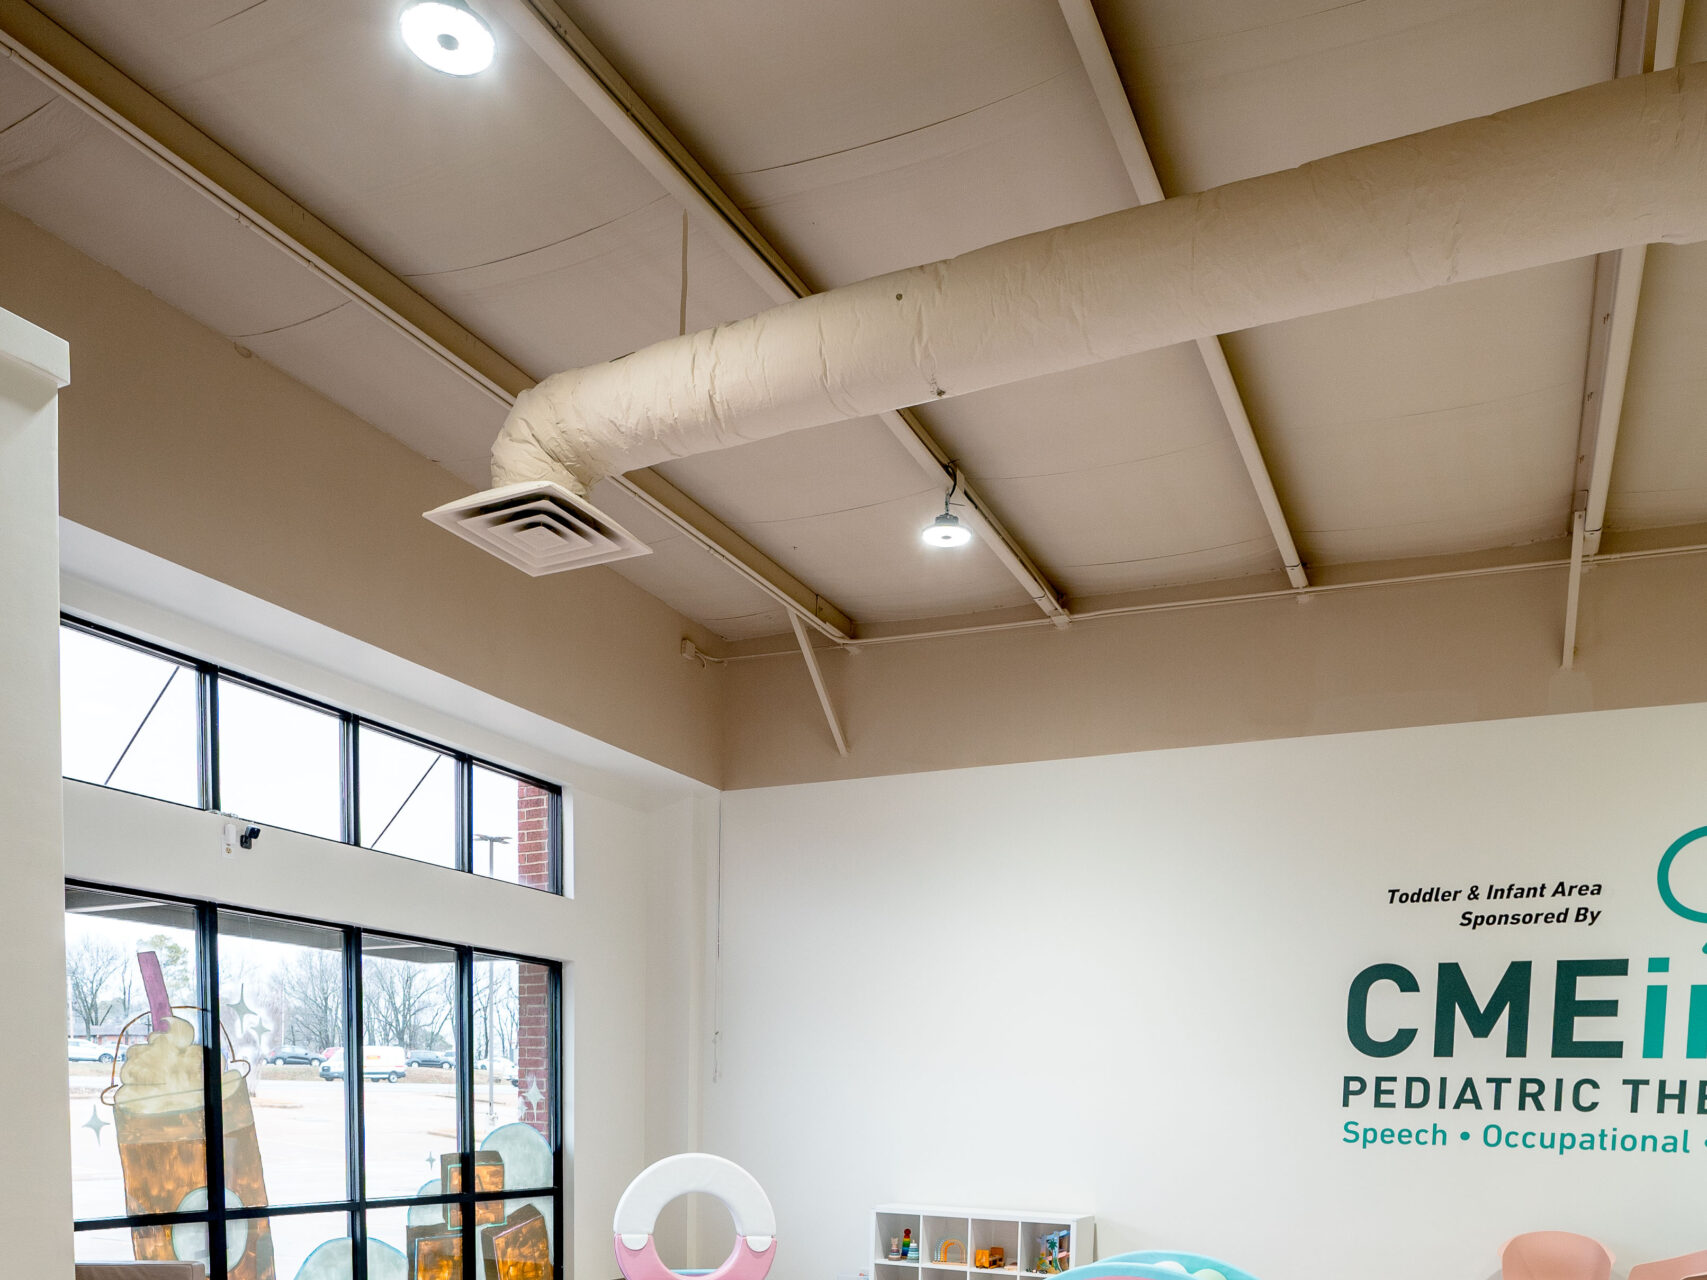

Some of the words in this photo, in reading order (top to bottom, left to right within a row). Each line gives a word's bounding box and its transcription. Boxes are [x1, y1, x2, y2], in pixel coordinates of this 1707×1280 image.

[1388, 887, 1462, 904] Toddler
[1467, 885, 1480, 900] &
[1487, 883, 1546, 900] Infant
[1551, 882, 1602, 897] Area
[1459, 908, 1569, 930] Sponsored
[1575, 907, 1601, 926] By
[1343, 1076, 1601, 1112] PEDIATRIC
[1343, 1121, 1447, 1149] Speech
[1483, 1124, 1690, 1155] Occupational
